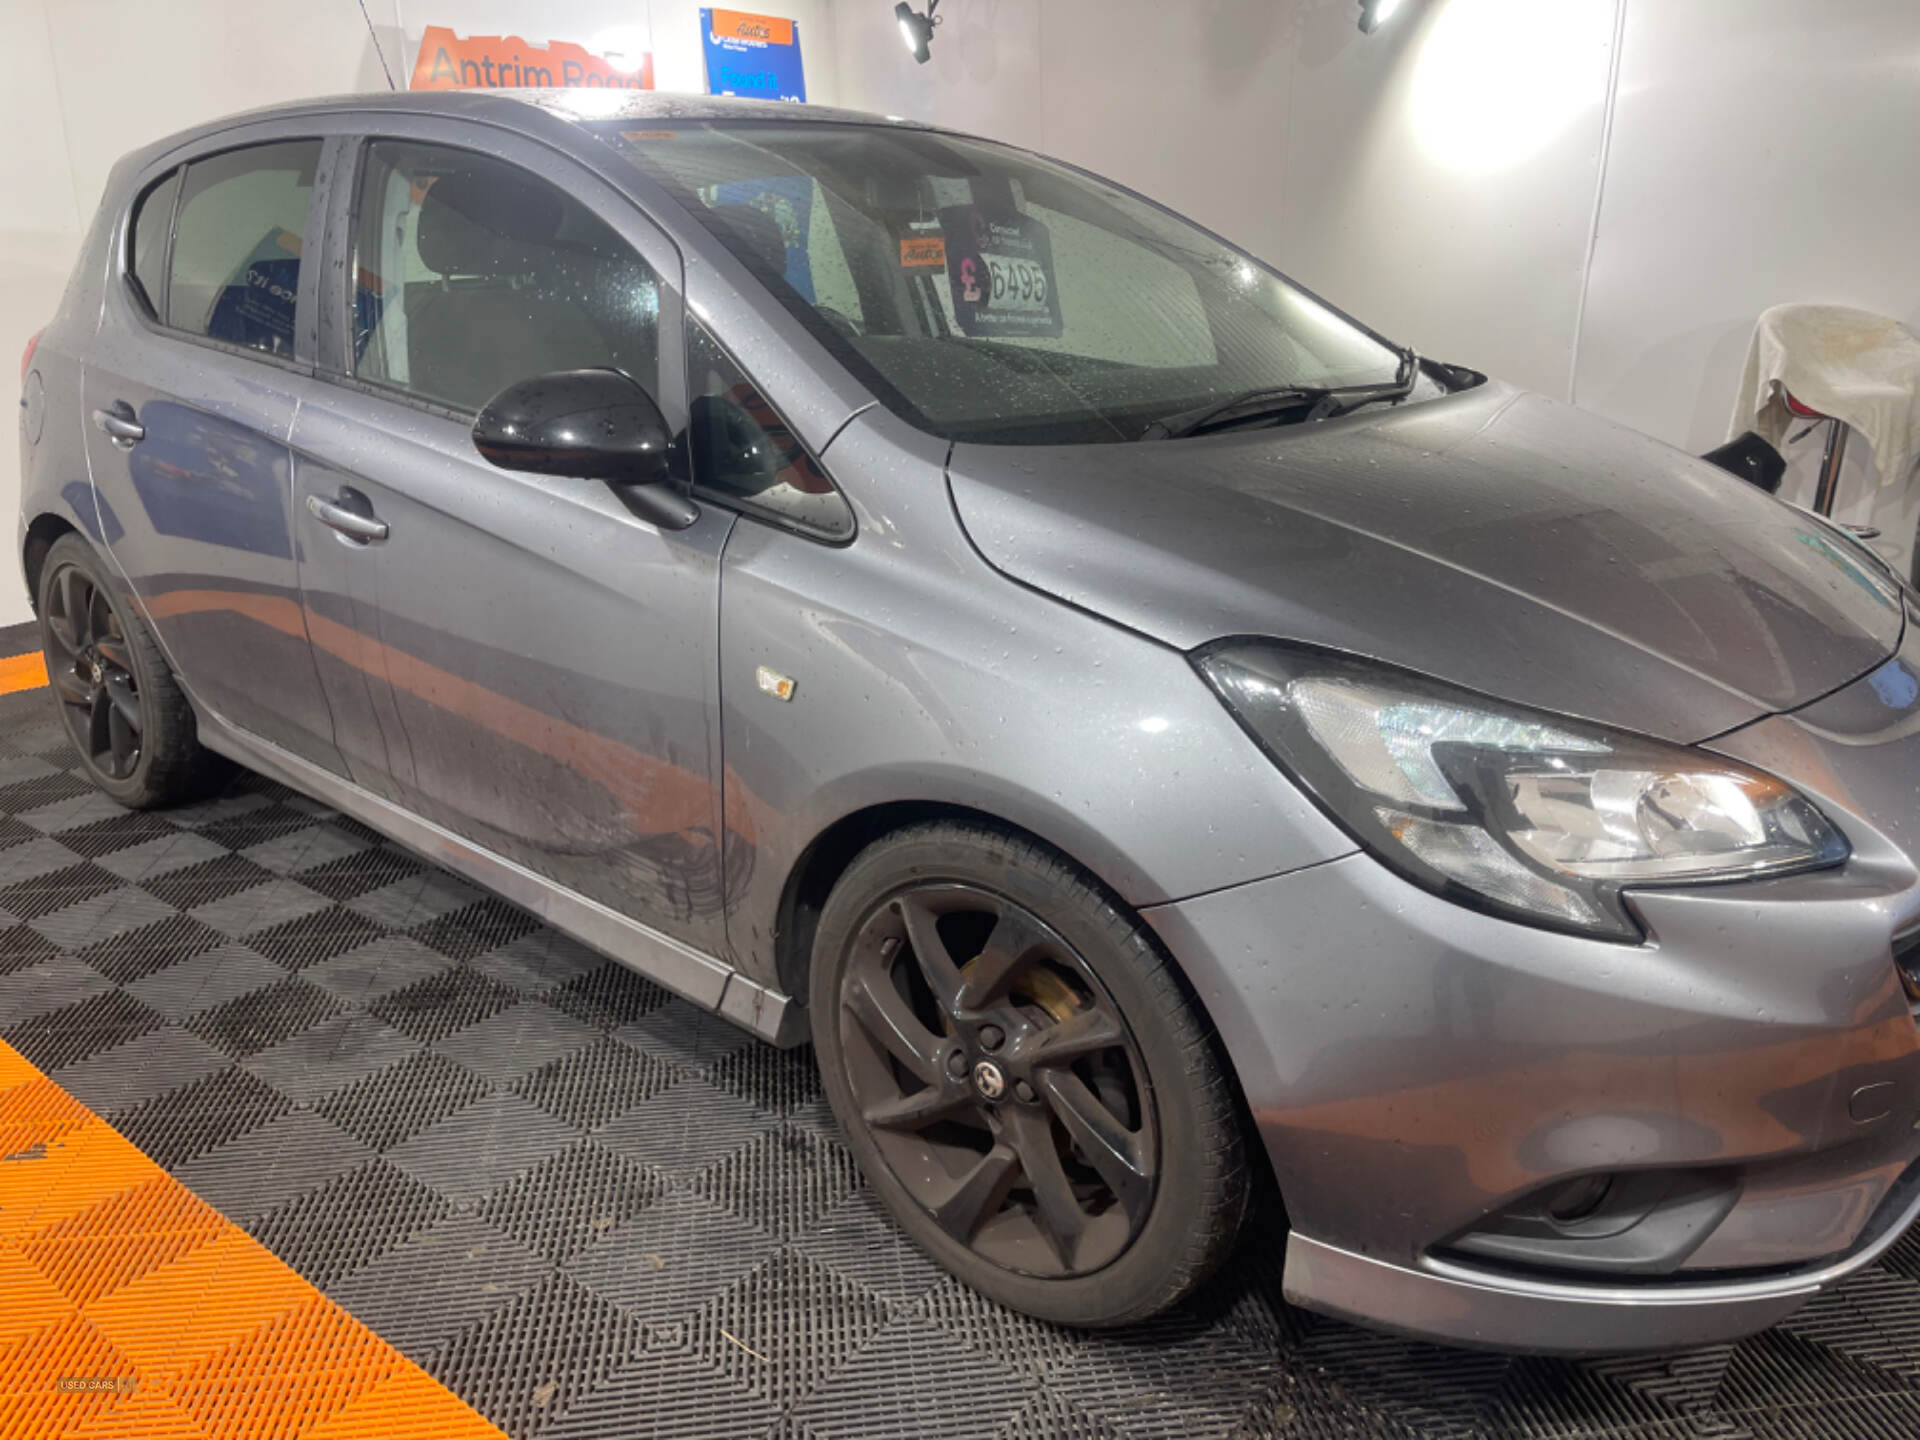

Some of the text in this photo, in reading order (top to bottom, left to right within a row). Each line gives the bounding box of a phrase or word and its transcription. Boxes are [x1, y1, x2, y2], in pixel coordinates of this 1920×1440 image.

[429, 48, 553, 88] Antrim
[721, 66, 779, 91] Found it
